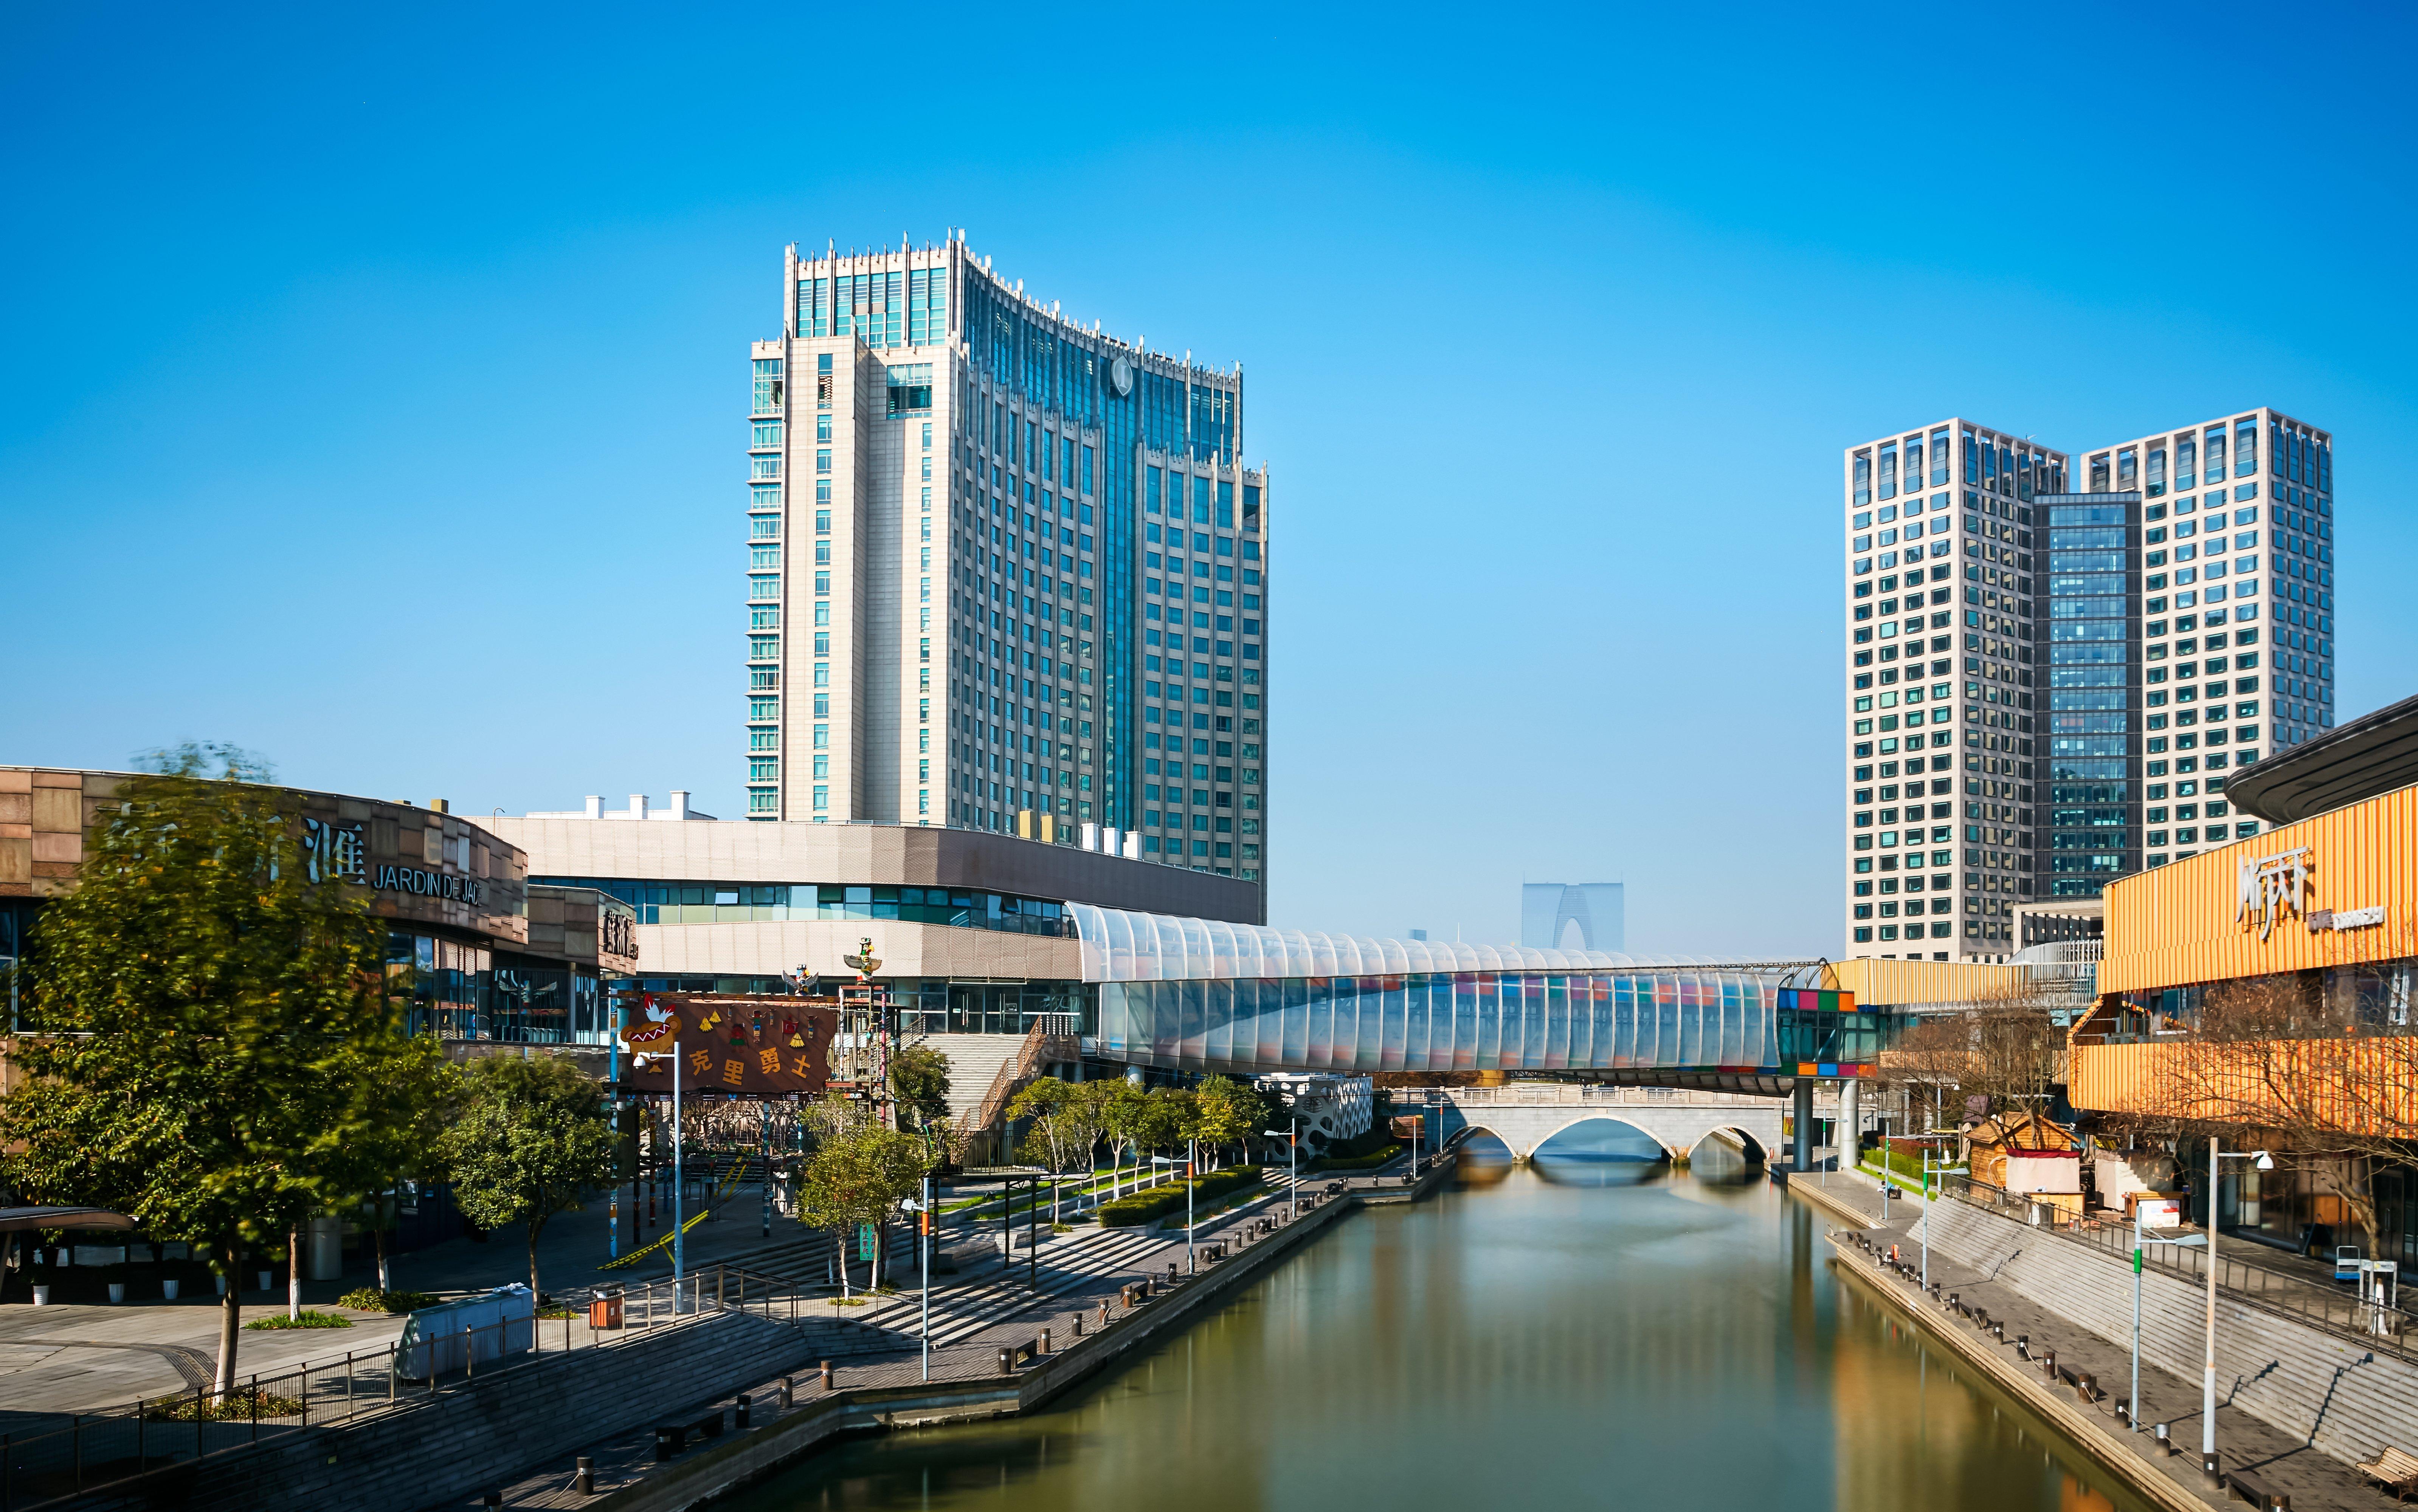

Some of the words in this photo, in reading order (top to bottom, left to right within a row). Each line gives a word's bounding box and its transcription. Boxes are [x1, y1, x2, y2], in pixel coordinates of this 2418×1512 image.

[374, 864, 440, 897] JARDIN
[444, 875, 459, 900] DE
[462, 878, 482, 907] JADE
[689, 1047, 811, 1086] 克里勇士
